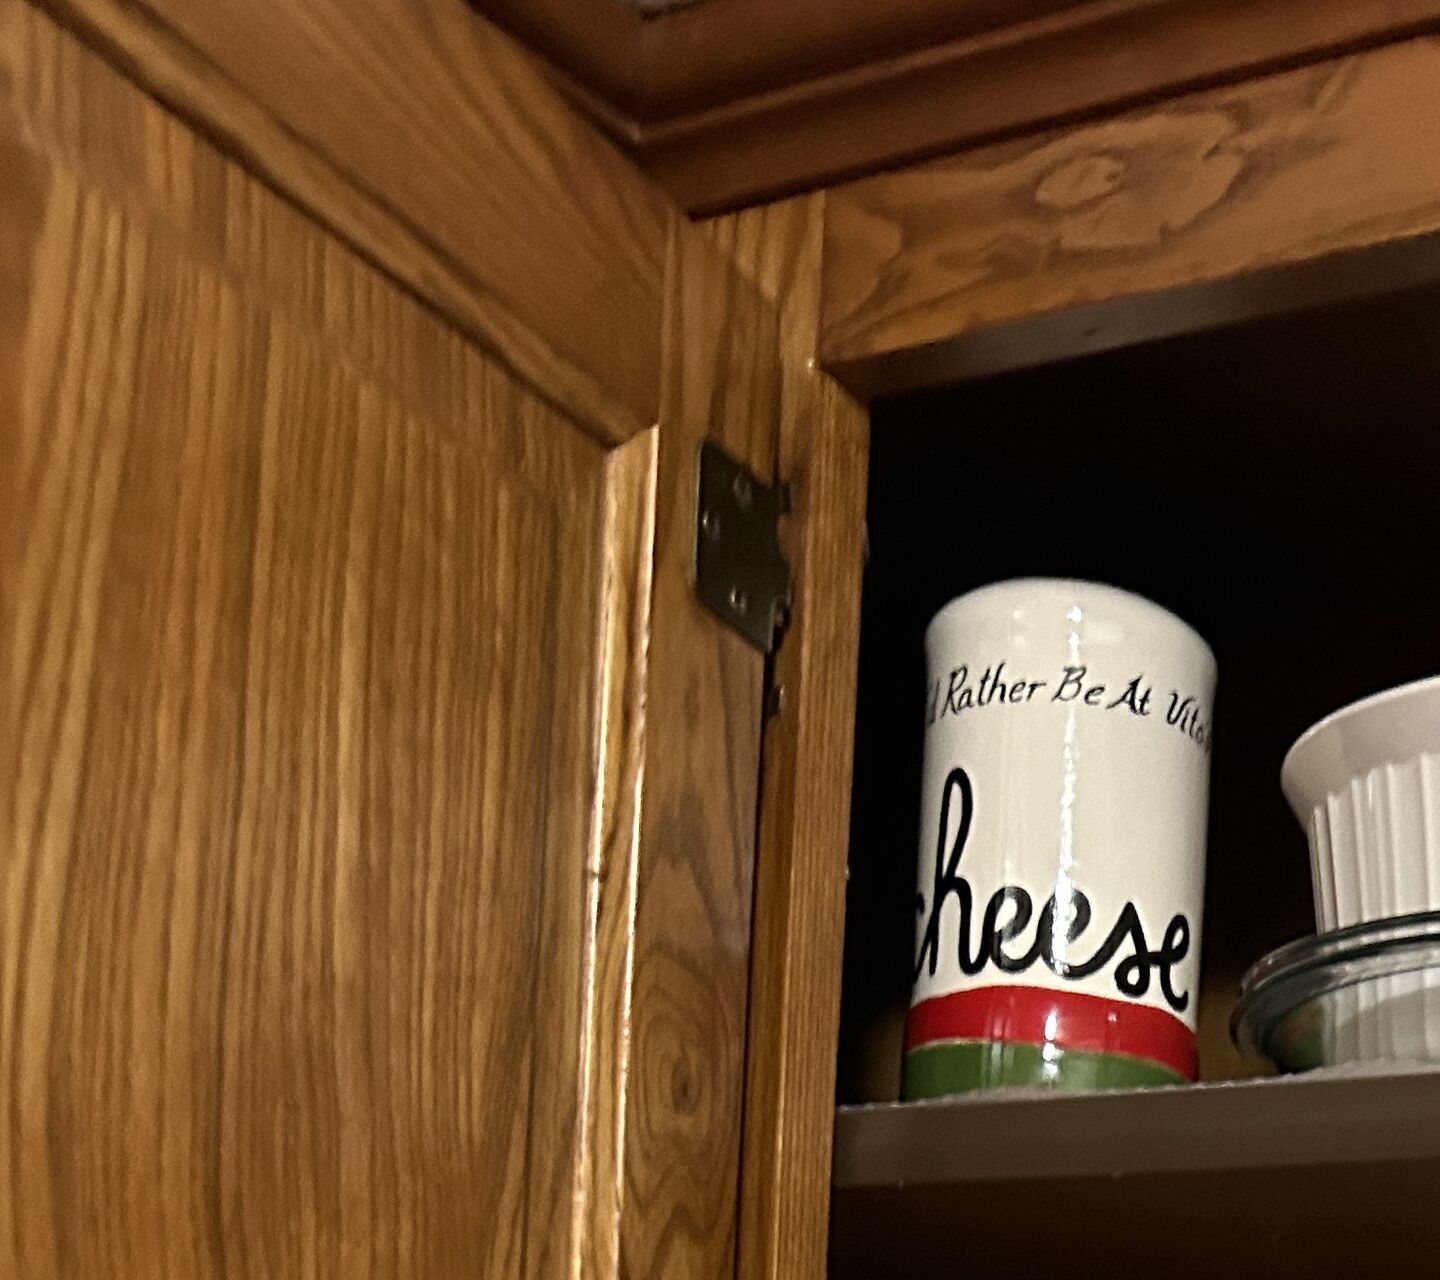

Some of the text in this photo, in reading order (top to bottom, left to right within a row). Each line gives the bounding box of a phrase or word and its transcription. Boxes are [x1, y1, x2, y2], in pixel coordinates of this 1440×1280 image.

[940, 662, 1047, 718] Rather
[1051, 664, 1105, 706] Be
[1106, 674, 1152, 716] At
[914, 767, 1190, 1012] heese
